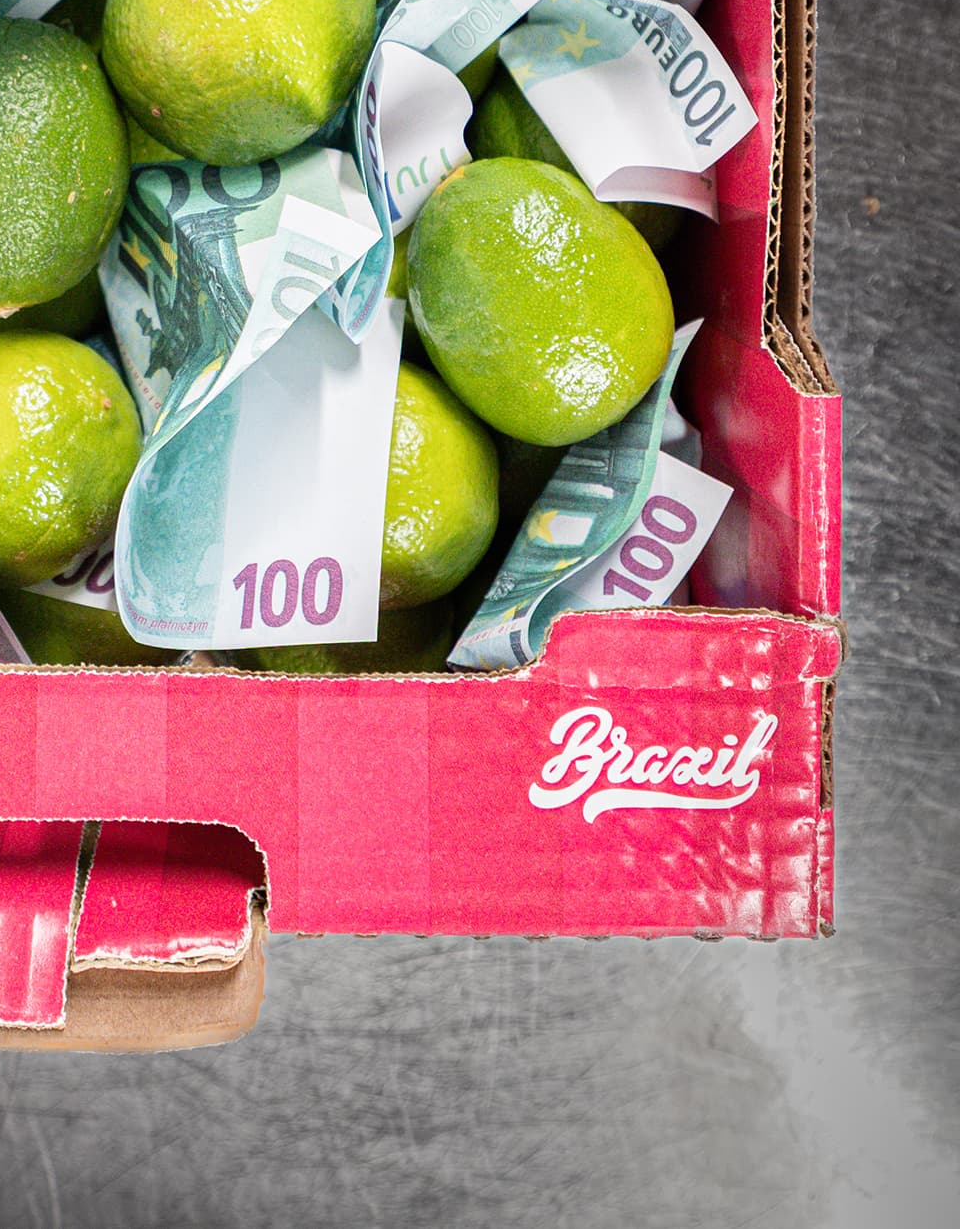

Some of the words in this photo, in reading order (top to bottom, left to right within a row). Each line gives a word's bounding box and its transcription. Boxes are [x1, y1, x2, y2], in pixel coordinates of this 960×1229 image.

[605, 4, 680, 73] EURO
[669, 49, 737, 147] 100
[232, 556, 344, 630] 100
[602, 494, 698, 602] 100
[529, 705, 779, 824] Brazil
